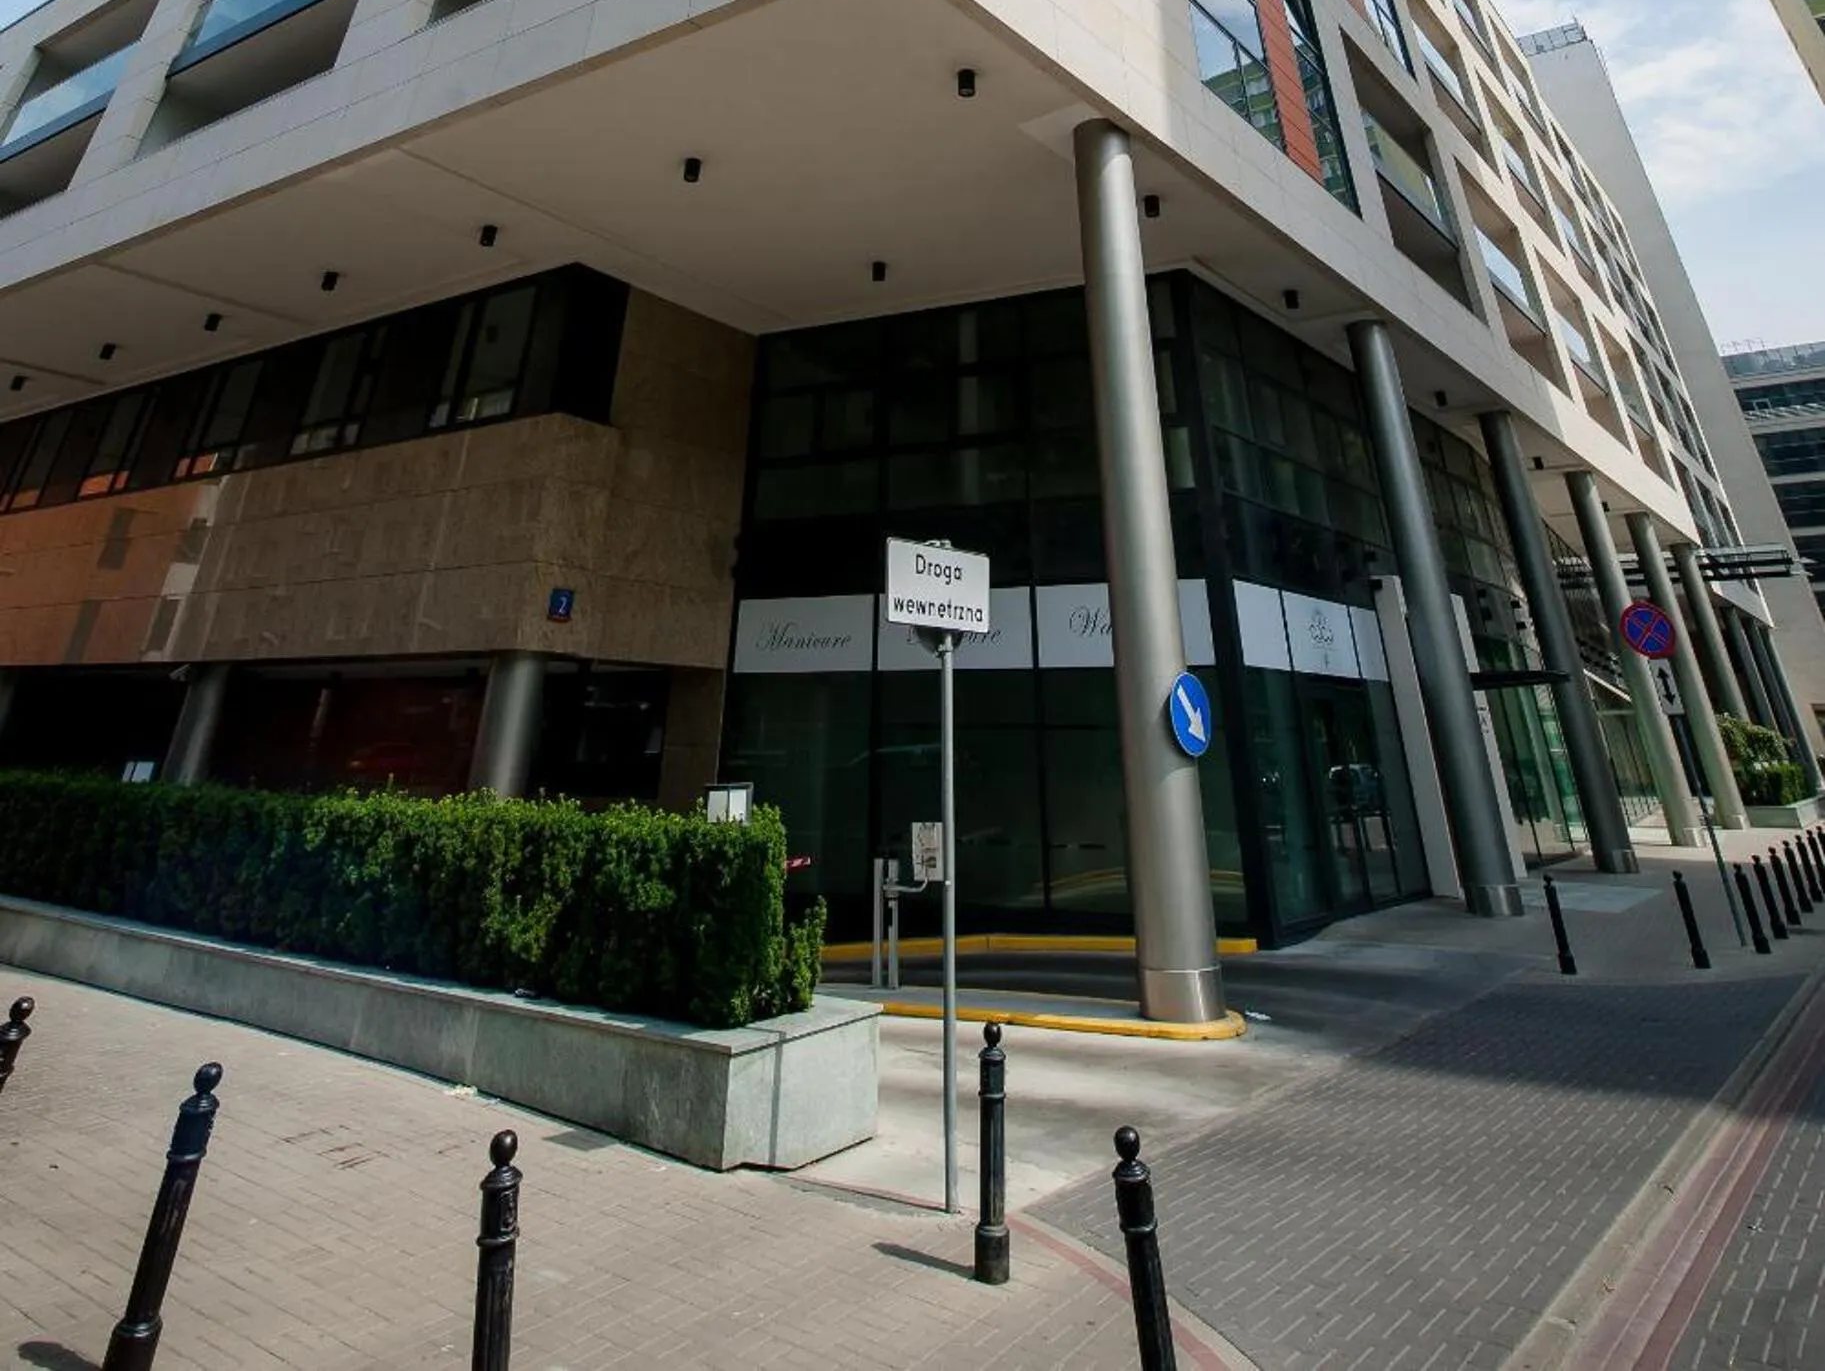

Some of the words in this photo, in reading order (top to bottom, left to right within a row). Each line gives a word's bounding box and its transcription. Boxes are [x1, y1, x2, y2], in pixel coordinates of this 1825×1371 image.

[915, 553, 962, 585] Droga
[559, 596, 568, 615] 2
[755, 620, 852, 649] Manicure
